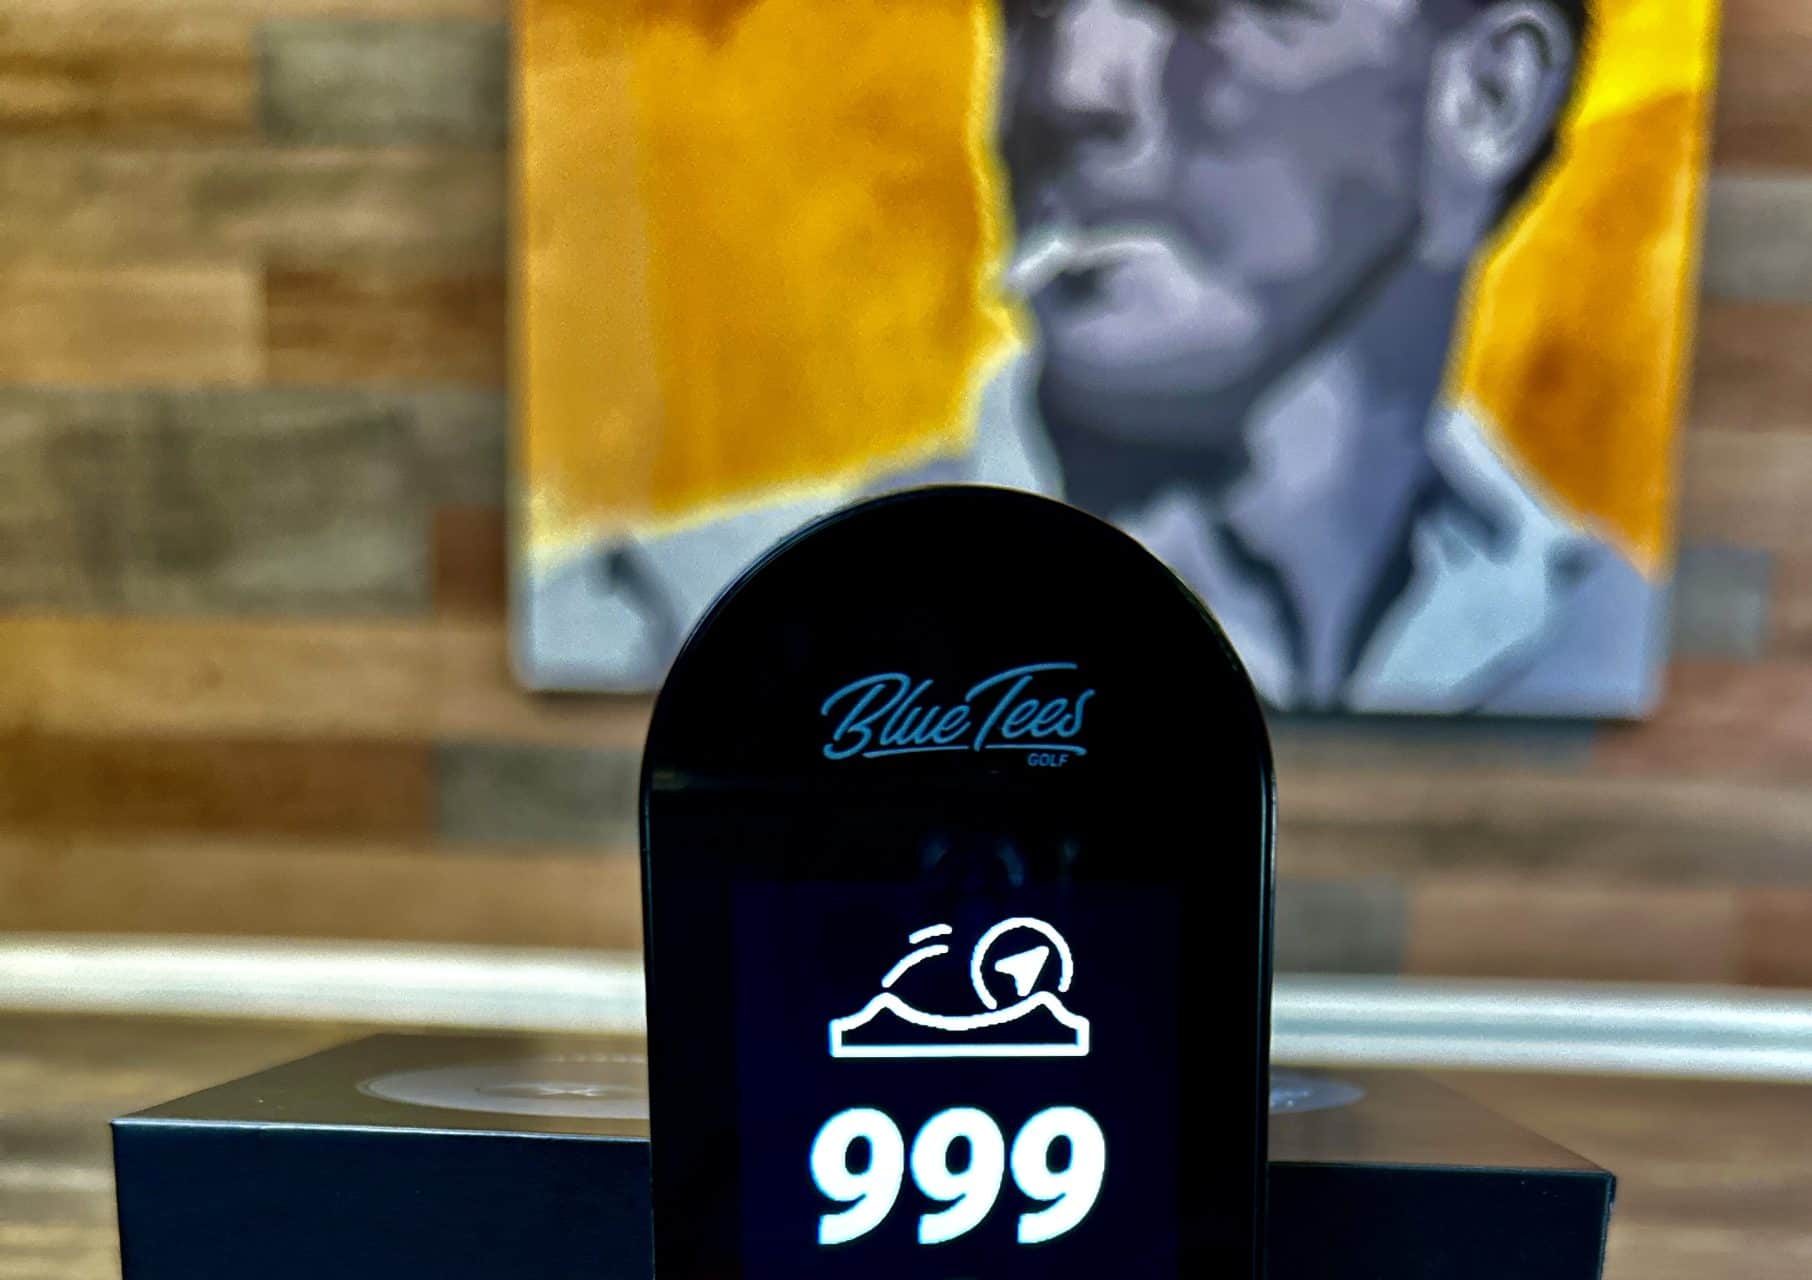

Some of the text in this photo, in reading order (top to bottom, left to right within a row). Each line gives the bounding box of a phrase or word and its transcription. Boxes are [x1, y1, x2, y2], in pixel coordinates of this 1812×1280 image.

[821, 661, 1095, 760] Blue Tees
[1027, 753, 1069, 767] GOLF
[811, 1106, 1106, 1246] 999
